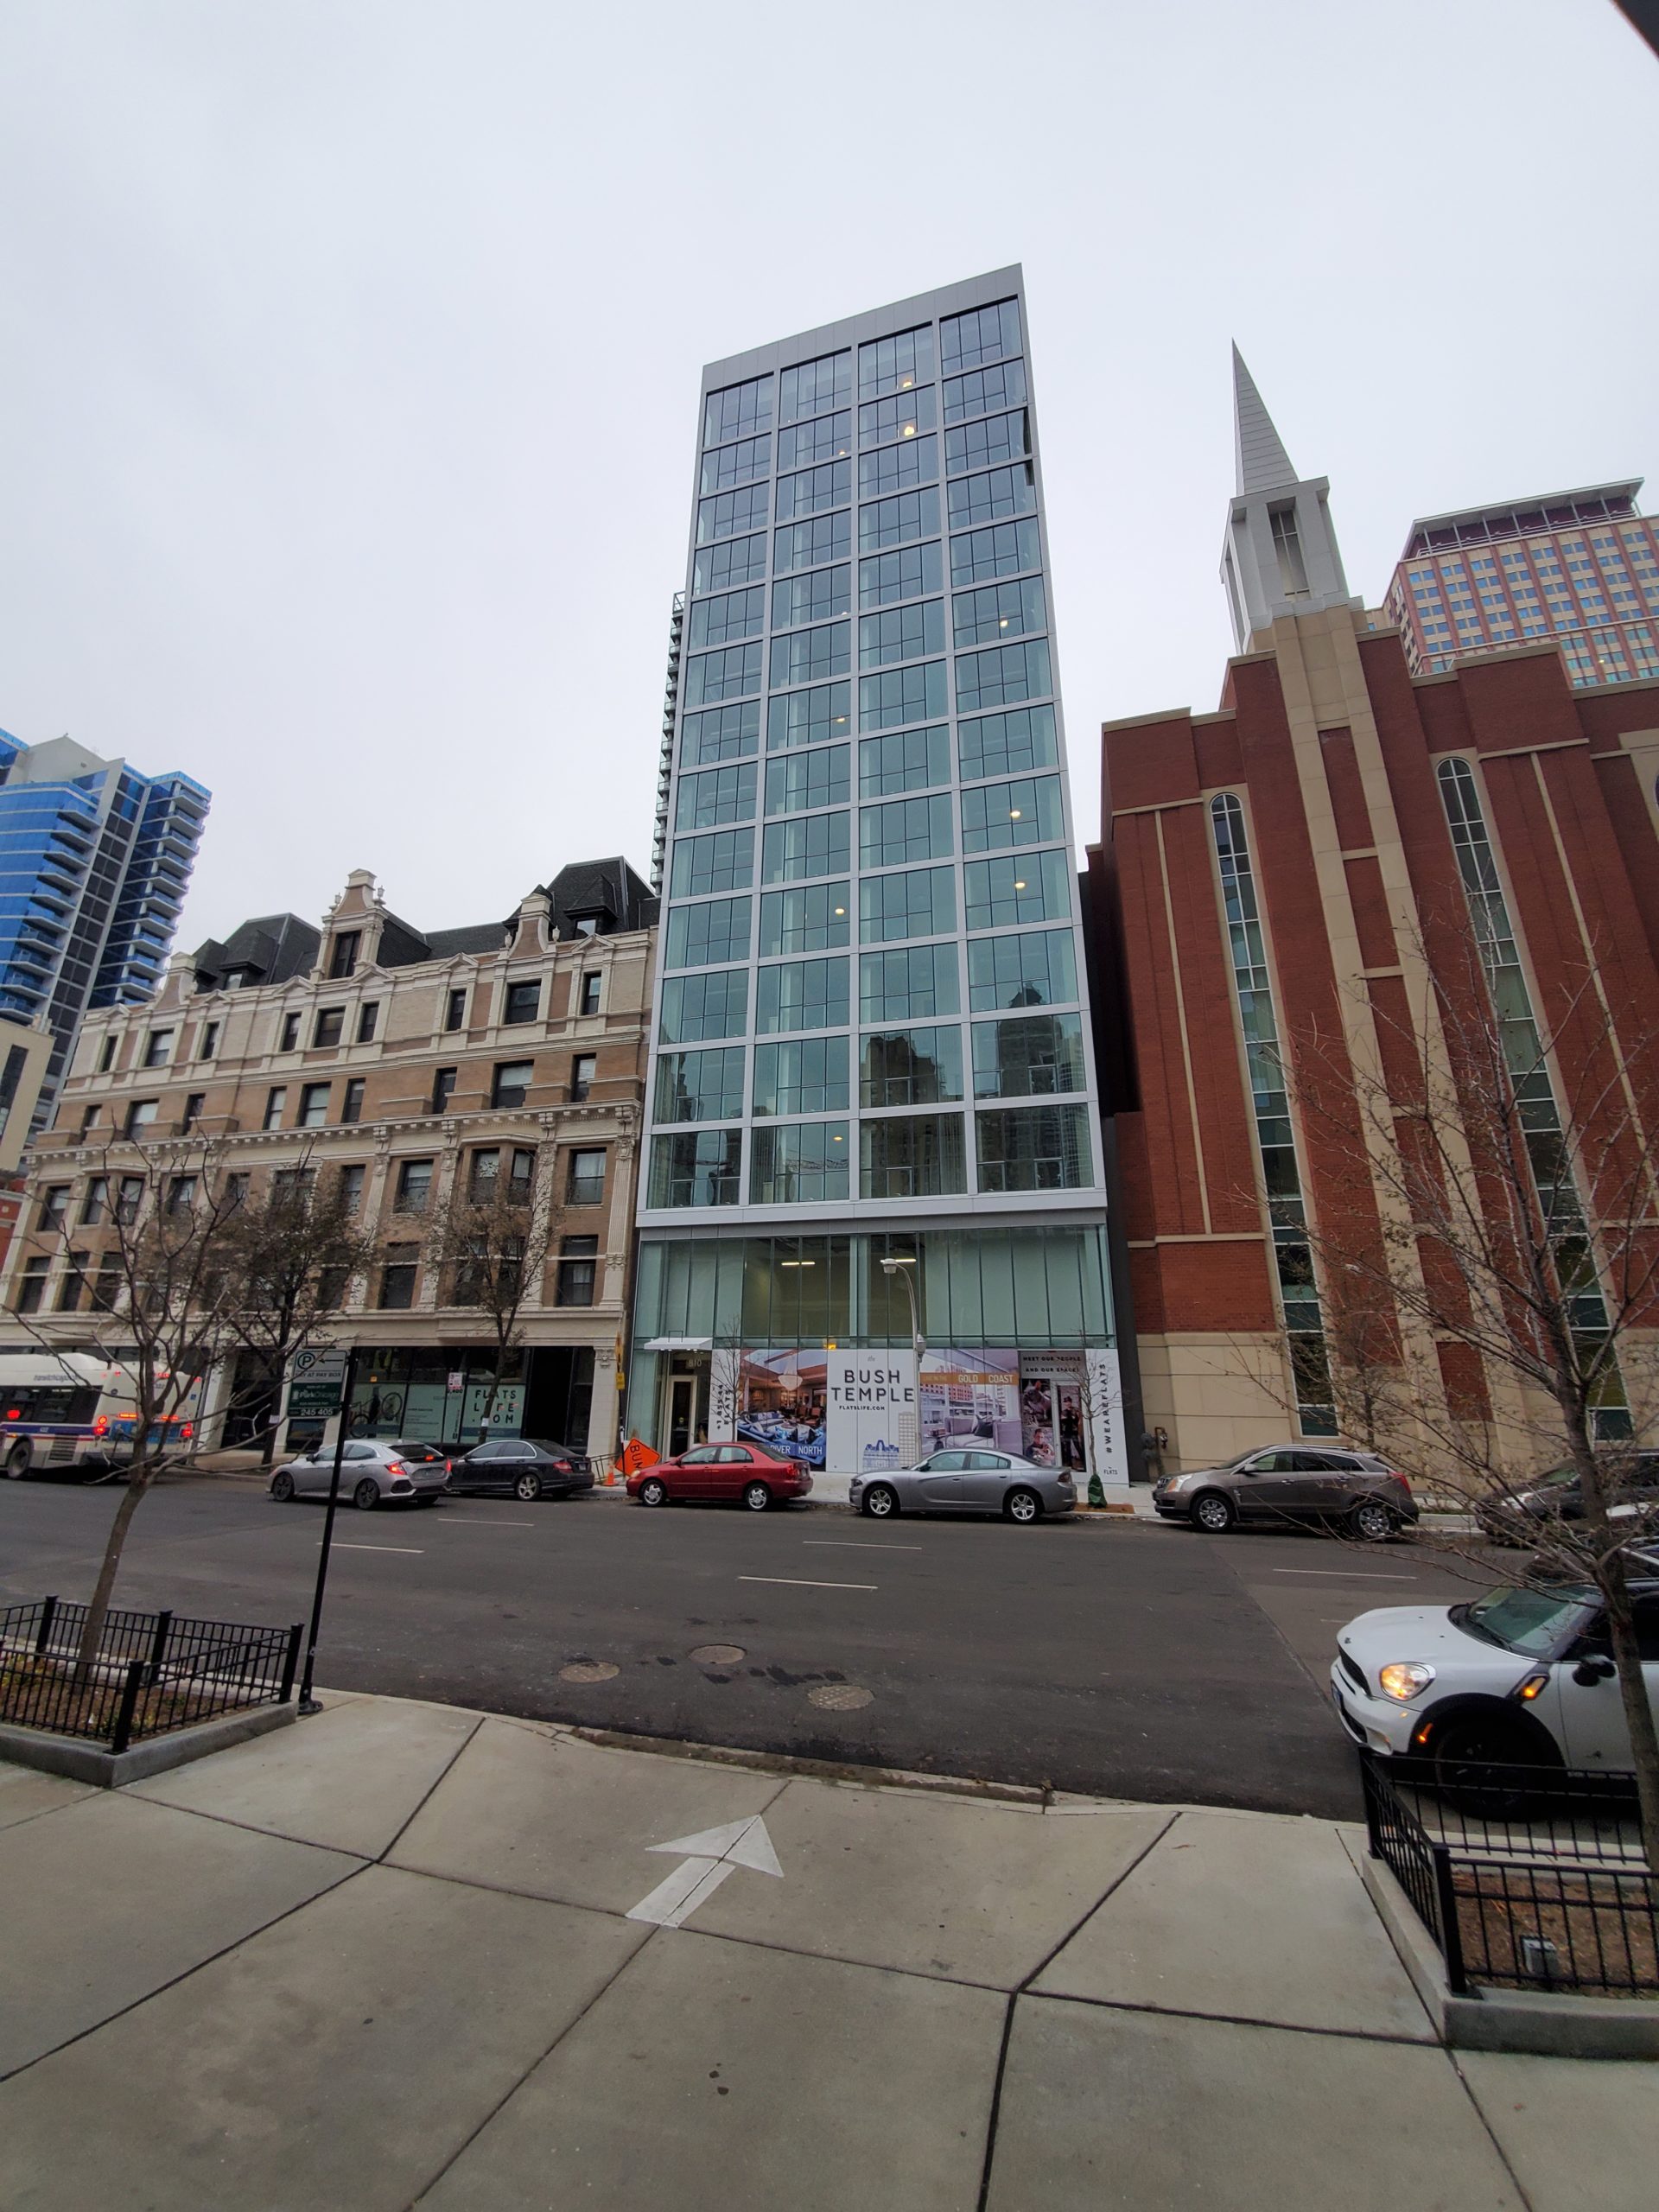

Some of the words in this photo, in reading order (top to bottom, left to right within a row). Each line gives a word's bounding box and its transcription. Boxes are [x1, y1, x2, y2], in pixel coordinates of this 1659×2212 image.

[688, 1358, 702, 1368] 810
[844, 1369, 900, 1383] BUSH
[958, 1374, 978, 1383] GOLD
[988, 1374, 1014, 1383] COAST
[475, 1389, 517, 1399] FLTS
[831, 1387, 914, 1402] TEMPLE
[474, 1402, 514, 1412] LFE
[1099, 1363, 1113, 1453] #WEAREFLATS
[473, 1414, 513, 1424] .OM
[798, 1445, 823, 1455] NORTH
